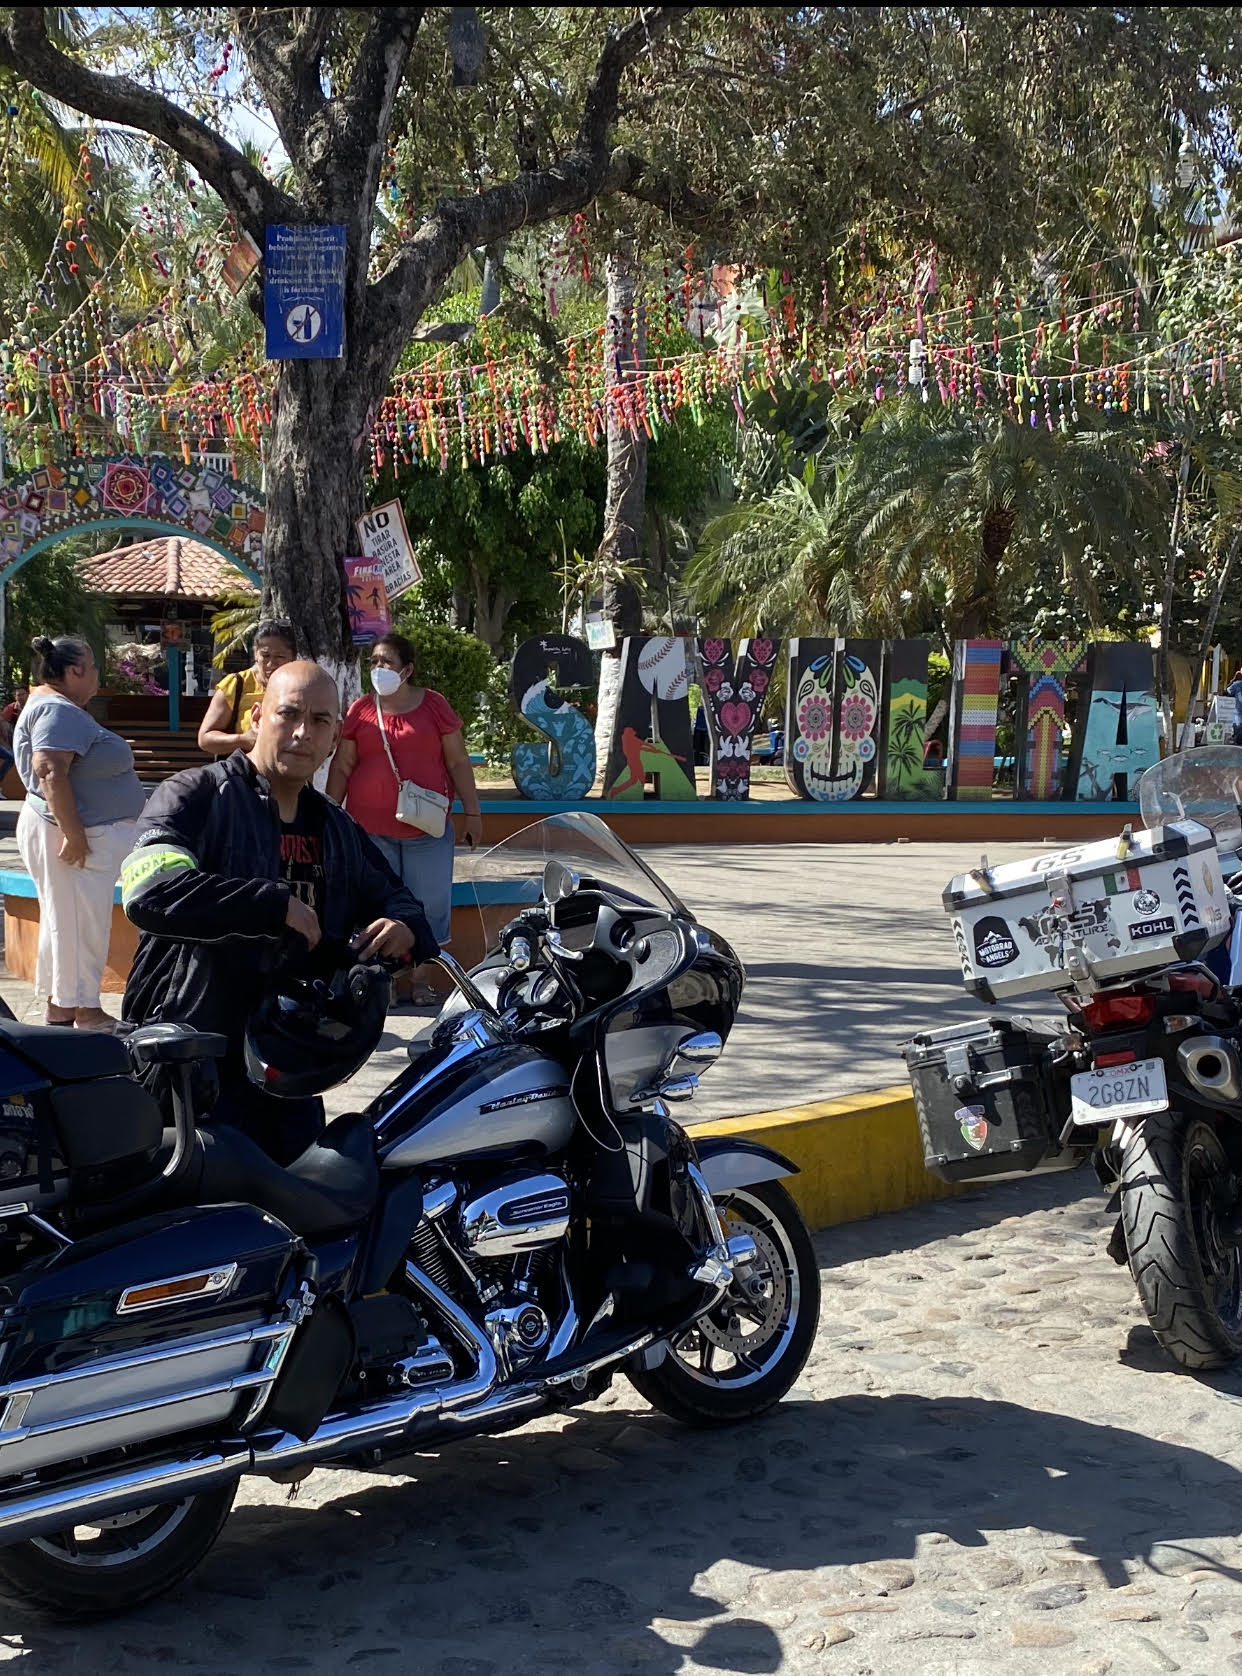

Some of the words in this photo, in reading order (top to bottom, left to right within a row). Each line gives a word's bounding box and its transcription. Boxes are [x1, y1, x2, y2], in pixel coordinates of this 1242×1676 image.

[363, 511, 390, 538] NO
[371, 529, 391, 547] TIRAR
[384, 560, 402, 577] AREA
[384, 571, 413, 594] GRACIAS
[510, 633, 1161, 801] SAYULITA
[1031, 848, 1086, 872] GS
[1034, 923, 1109, 947] ADVENTURE
[1131, 920, 1174, 937] KOHL
[978, 941, 1013, 957] MOTORRAD
[985, 950, 1010, 963] ANGELS
[1088, 1075, 1151, 1107] 2G8ZN
